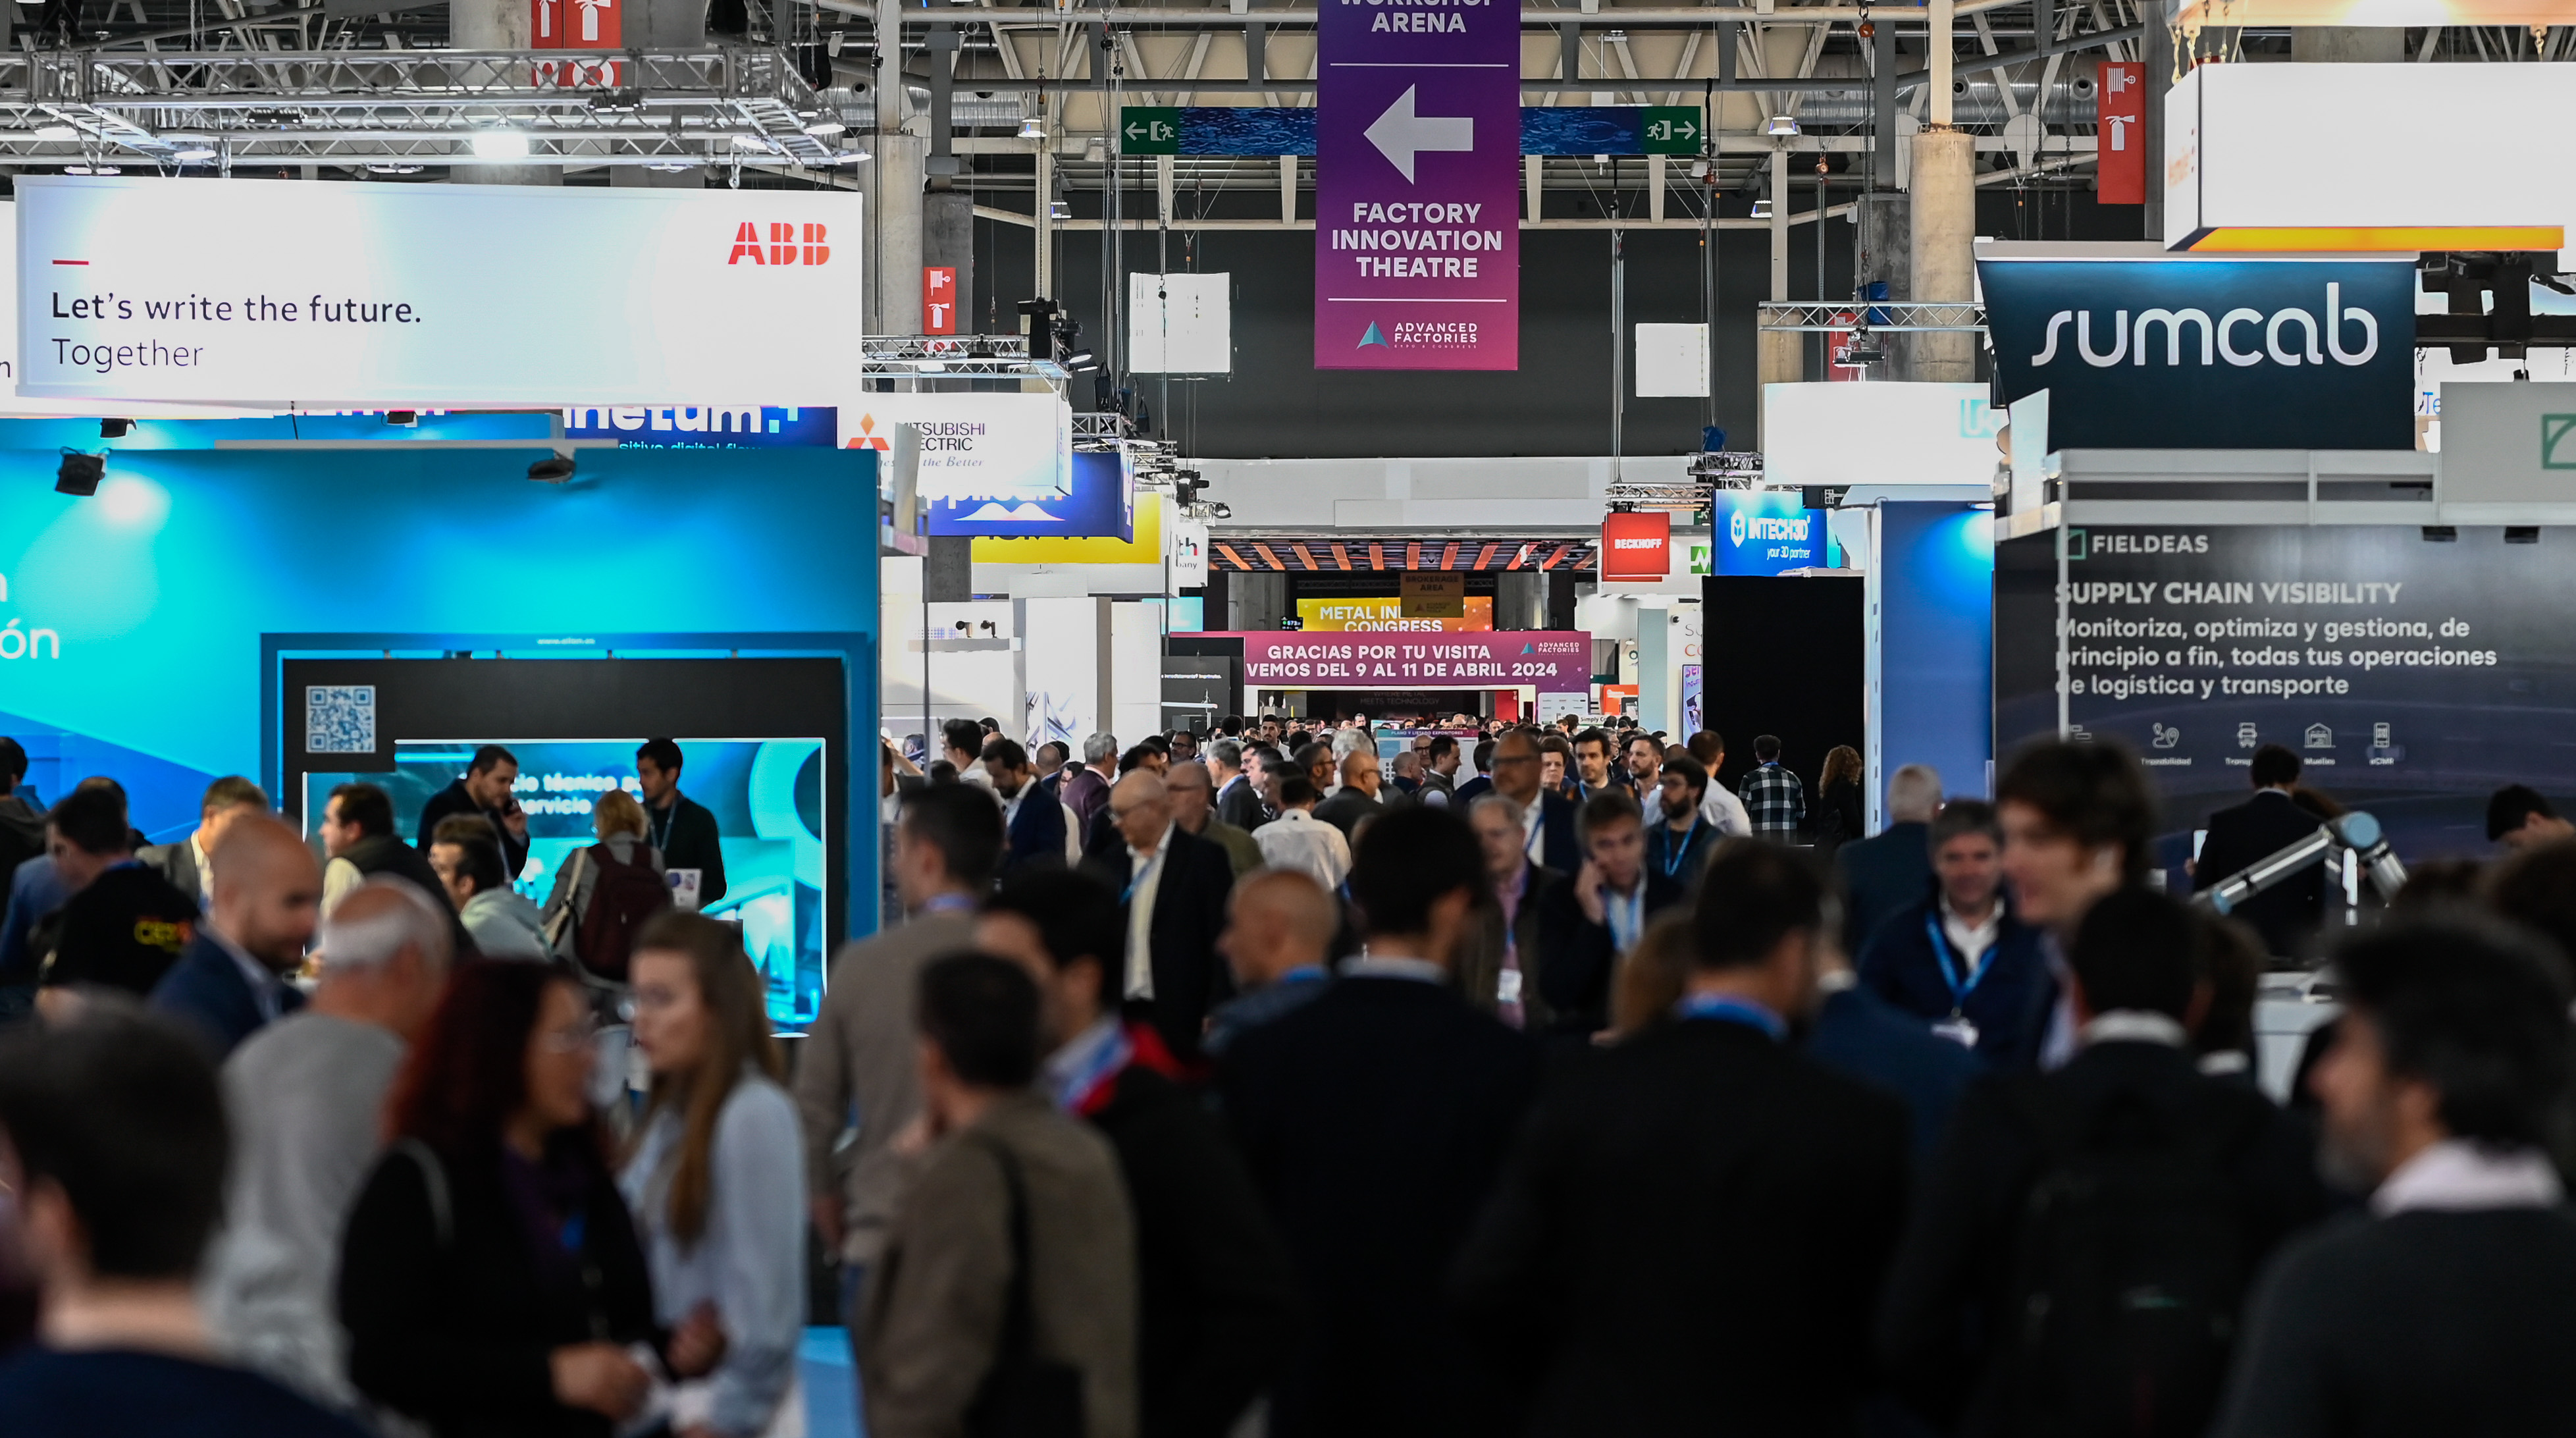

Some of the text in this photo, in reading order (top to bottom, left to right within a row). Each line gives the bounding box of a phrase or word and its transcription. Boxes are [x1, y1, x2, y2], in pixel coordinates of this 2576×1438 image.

[1371, 12, 1467, 32] ARENA
[1354, 202, 1482, 223] FACTORY
[727, 222, 831, 266] ABB
[1332, 229, 1502, 251] INNOVATION
[1356, 257, 1478, 277] THEATRE
[53, 292, 421, 323] Let’s write the future.
[1394, 322, 1478, 333] ADVANCED
[2031, 282, 2379, 367] sumcab
[1394, 333, 1478, 343] FACTORIES
[51, 338, 203, 373] Together
[947, 456, 985, 467] Better
[1614, 538, 1662, 550] BECKHOFF
[1780, 546, 1789, 558] 3D
[1789, 546, 1810, 560] partner
[2091, 535, 2209, 553] FIELDEAS
[2163, 582, 2253, 604] CHAIN
[2260, 582, 2403, 604] VISIBILITY
[1319, 606, 1375, 620] METAL
[1344, 620, 1442, 631] CONGRESS
[2194, 617, 2298, 643] optimiza
[2304, 622, 2318, 643] y
[2324, 617, 2434, 643] gestiona,
[2439, 617, 2471, 637] de
[1267, 645, 1491, 659] GRACIAS POR TU VISITA
[2165, 651, 2182, 666] a
[2187, 645, 2224, 669] fin,
[2231, 645, 2300, 666] todas
[2306, 647, 2344, 666] tus
[2349, 646, 2498, 671] operaciones
[1246, 662, 1558, 677] VEMOS DEL 9 AL 11 DE ABRIL 2024
[2091, 674, 2194, 701] logística
[2200, 679, 2215, 700] y
[2221, 676, 2350, 700] transporte
